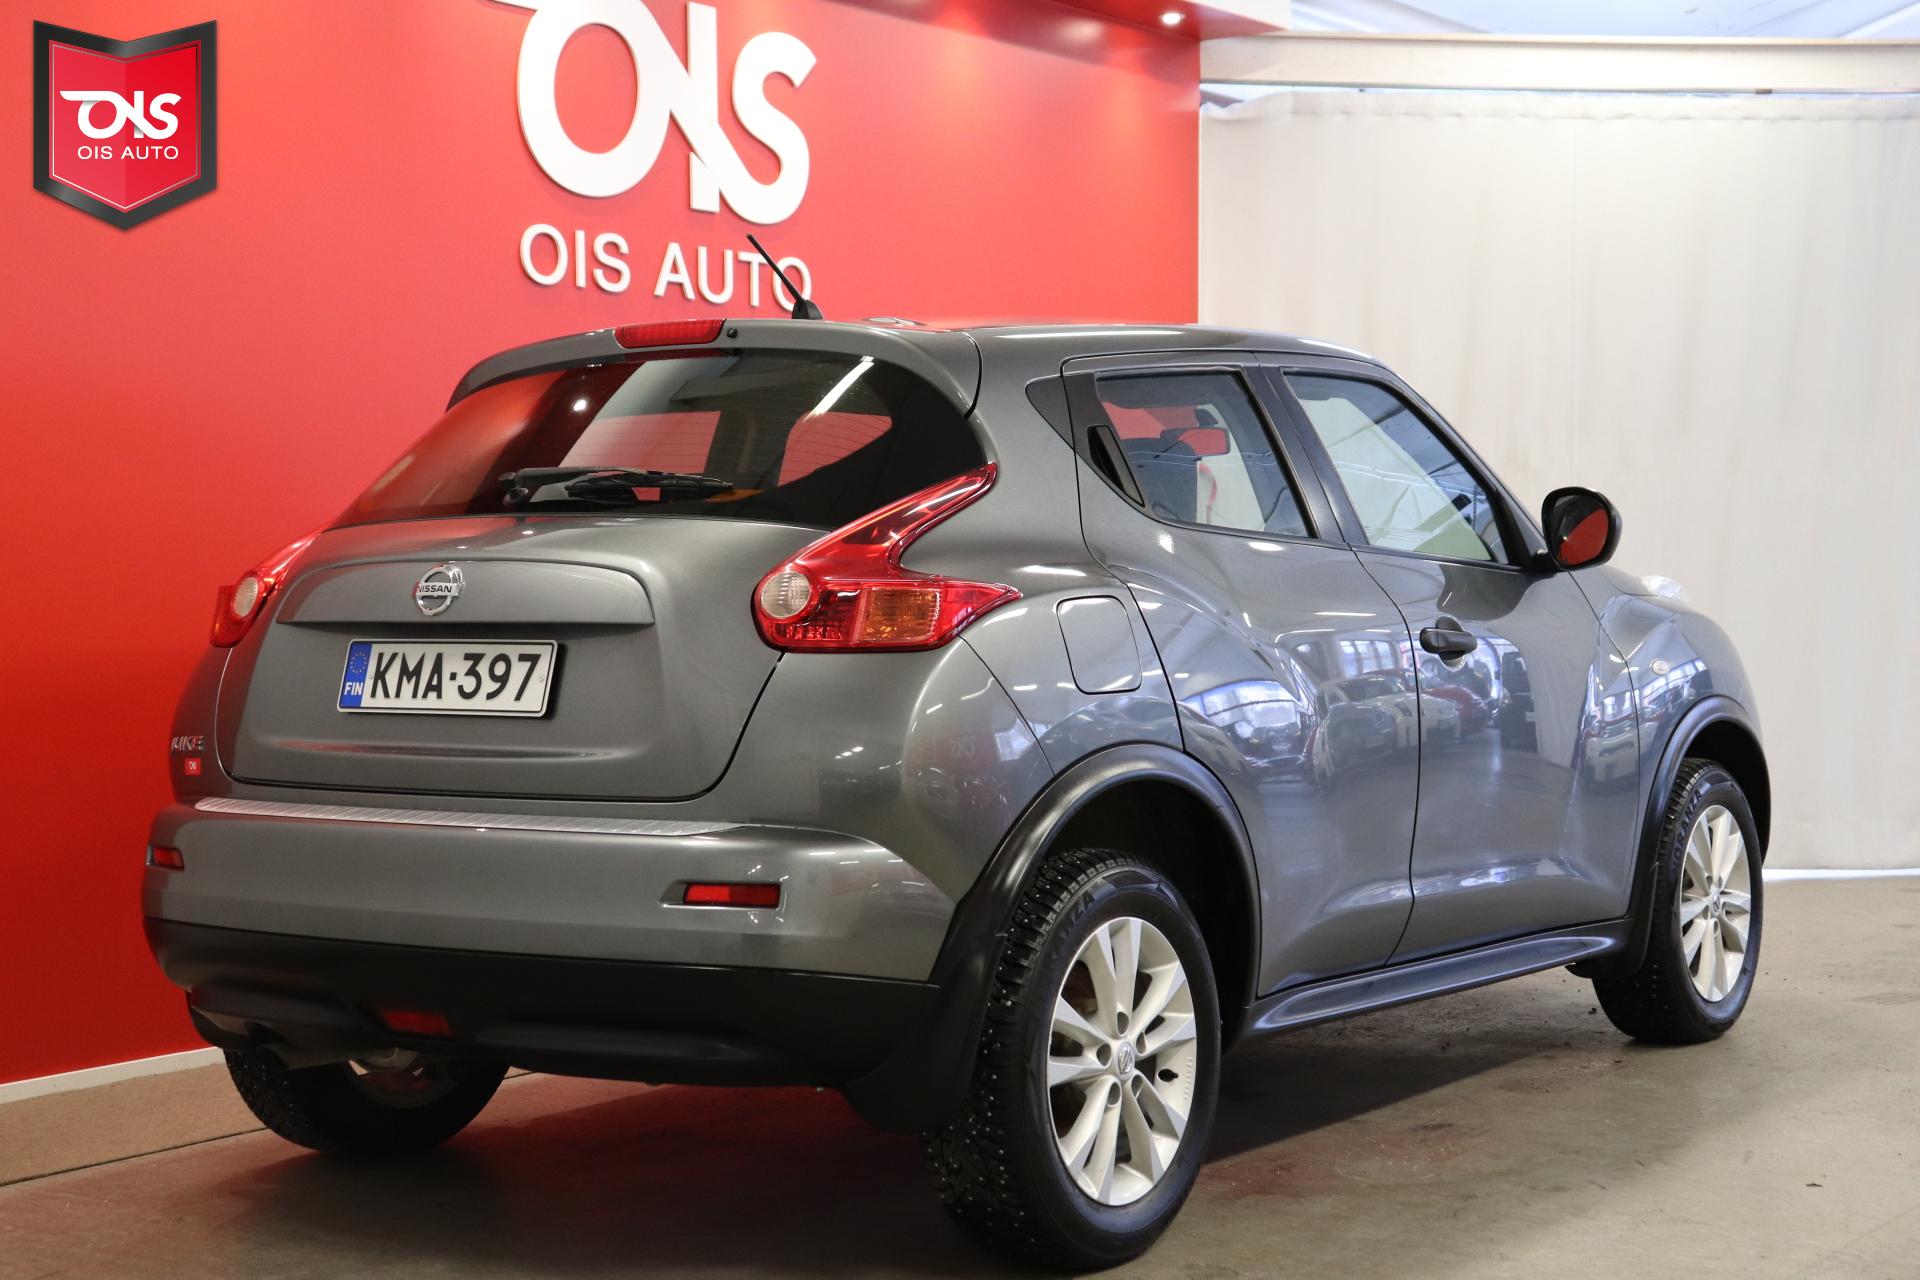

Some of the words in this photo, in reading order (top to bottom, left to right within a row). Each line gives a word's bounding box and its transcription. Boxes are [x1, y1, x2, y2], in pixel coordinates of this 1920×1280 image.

[487, 0, 818, 225] OIS
[519, 223, 632, 294] OIS
[653, 241, 813, 313] AUTO
[419, 584, 453, 593] NISSAN
[343, 681, 365, 696] FIN
[369, 651, 542, 702] KMA-397
